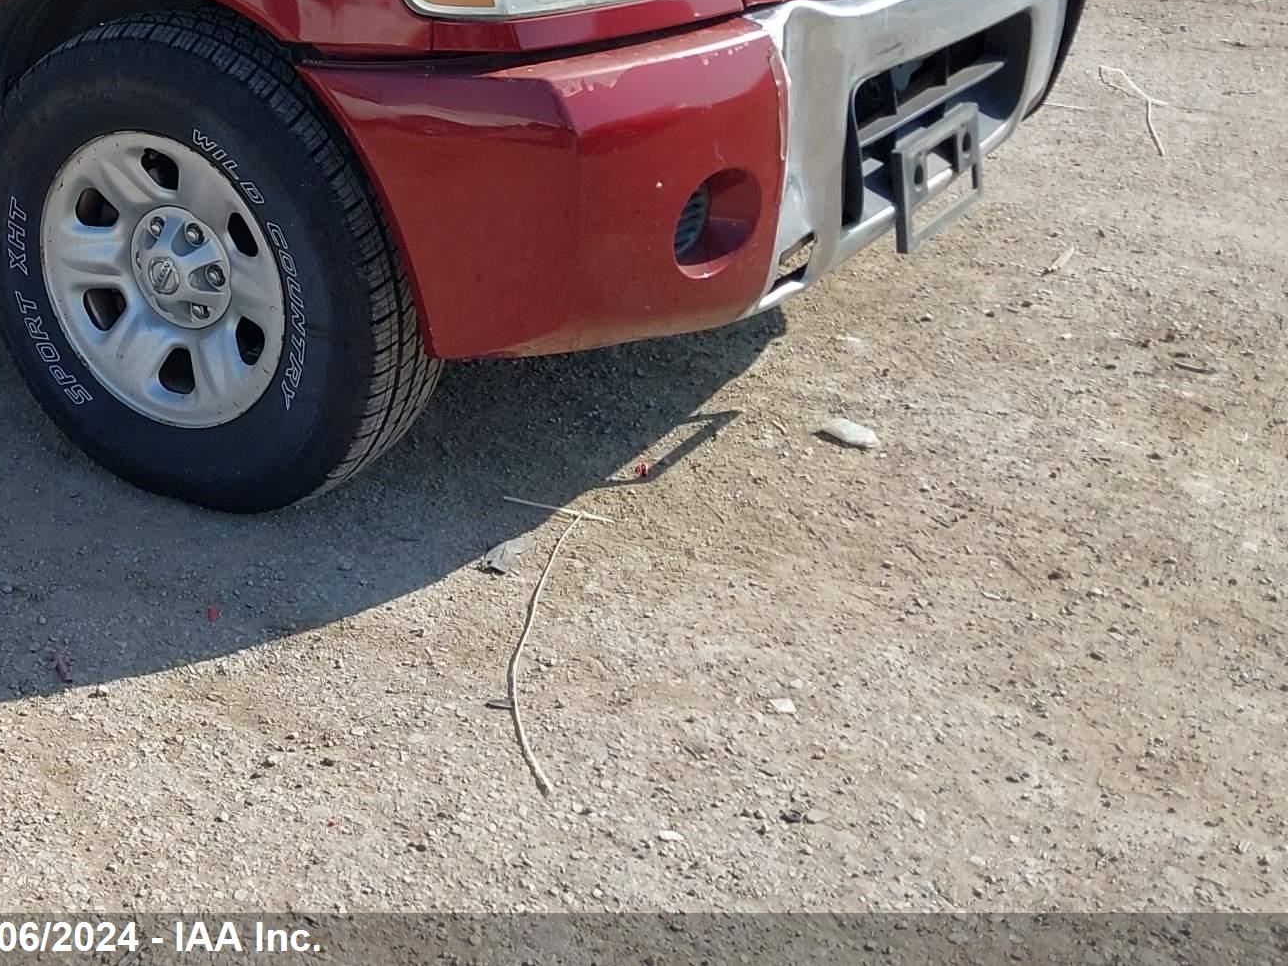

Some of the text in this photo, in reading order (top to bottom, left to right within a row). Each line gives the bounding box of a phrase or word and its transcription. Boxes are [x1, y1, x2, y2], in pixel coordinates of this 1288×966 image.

[7, 196, 93, 405] SPORT XHT
[192, 129, 307, 411] WILD COUNTRY
